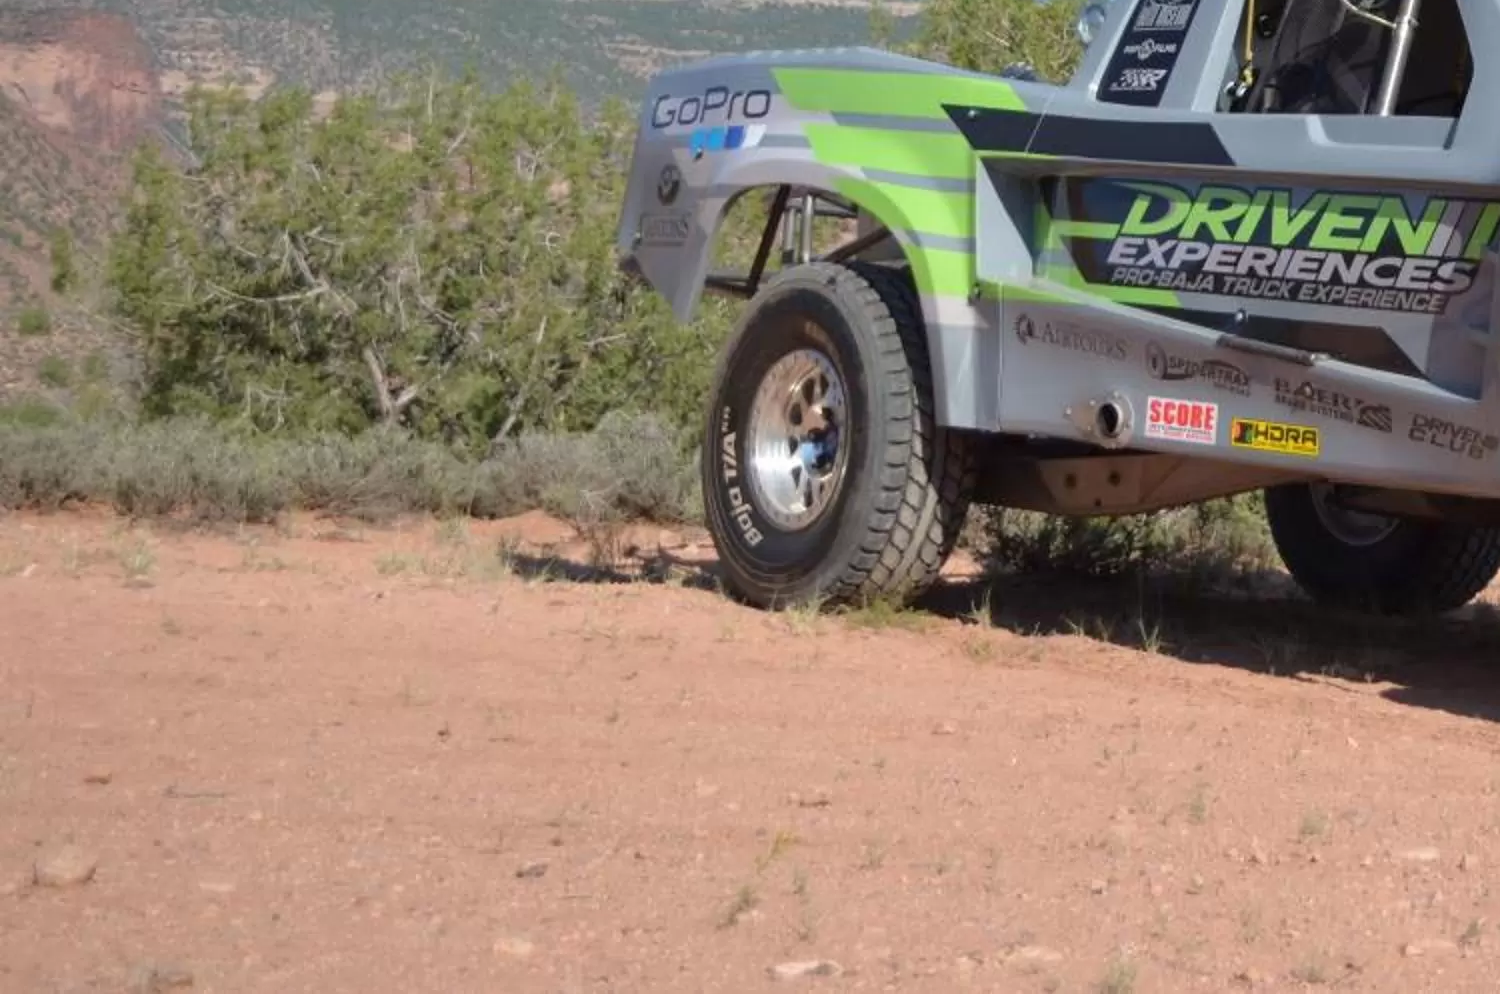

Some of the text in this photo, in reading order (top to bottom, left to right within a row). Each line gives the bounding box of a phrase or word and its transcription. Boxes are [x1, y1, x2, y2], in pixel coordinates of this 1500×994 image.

[651, 86, 771, 129] GoPro
[1115, 183, 1450, 256] DRIVEN
[1106, 236, 1482, 293] EXPERIENCES
[1222, 275, 1298, 300] TRUCK
[1299, 282, 1448, 313] EXPERIENCE
[1150, 398, 1215, 431] SCORE
[1412, 412, 1482, 444] DRIVEN
[1254, 423, 1317, 446] HDRA
[1408, 426, 1484, 460] CLUB
[721, 431, 764, 546] Baja T/A
